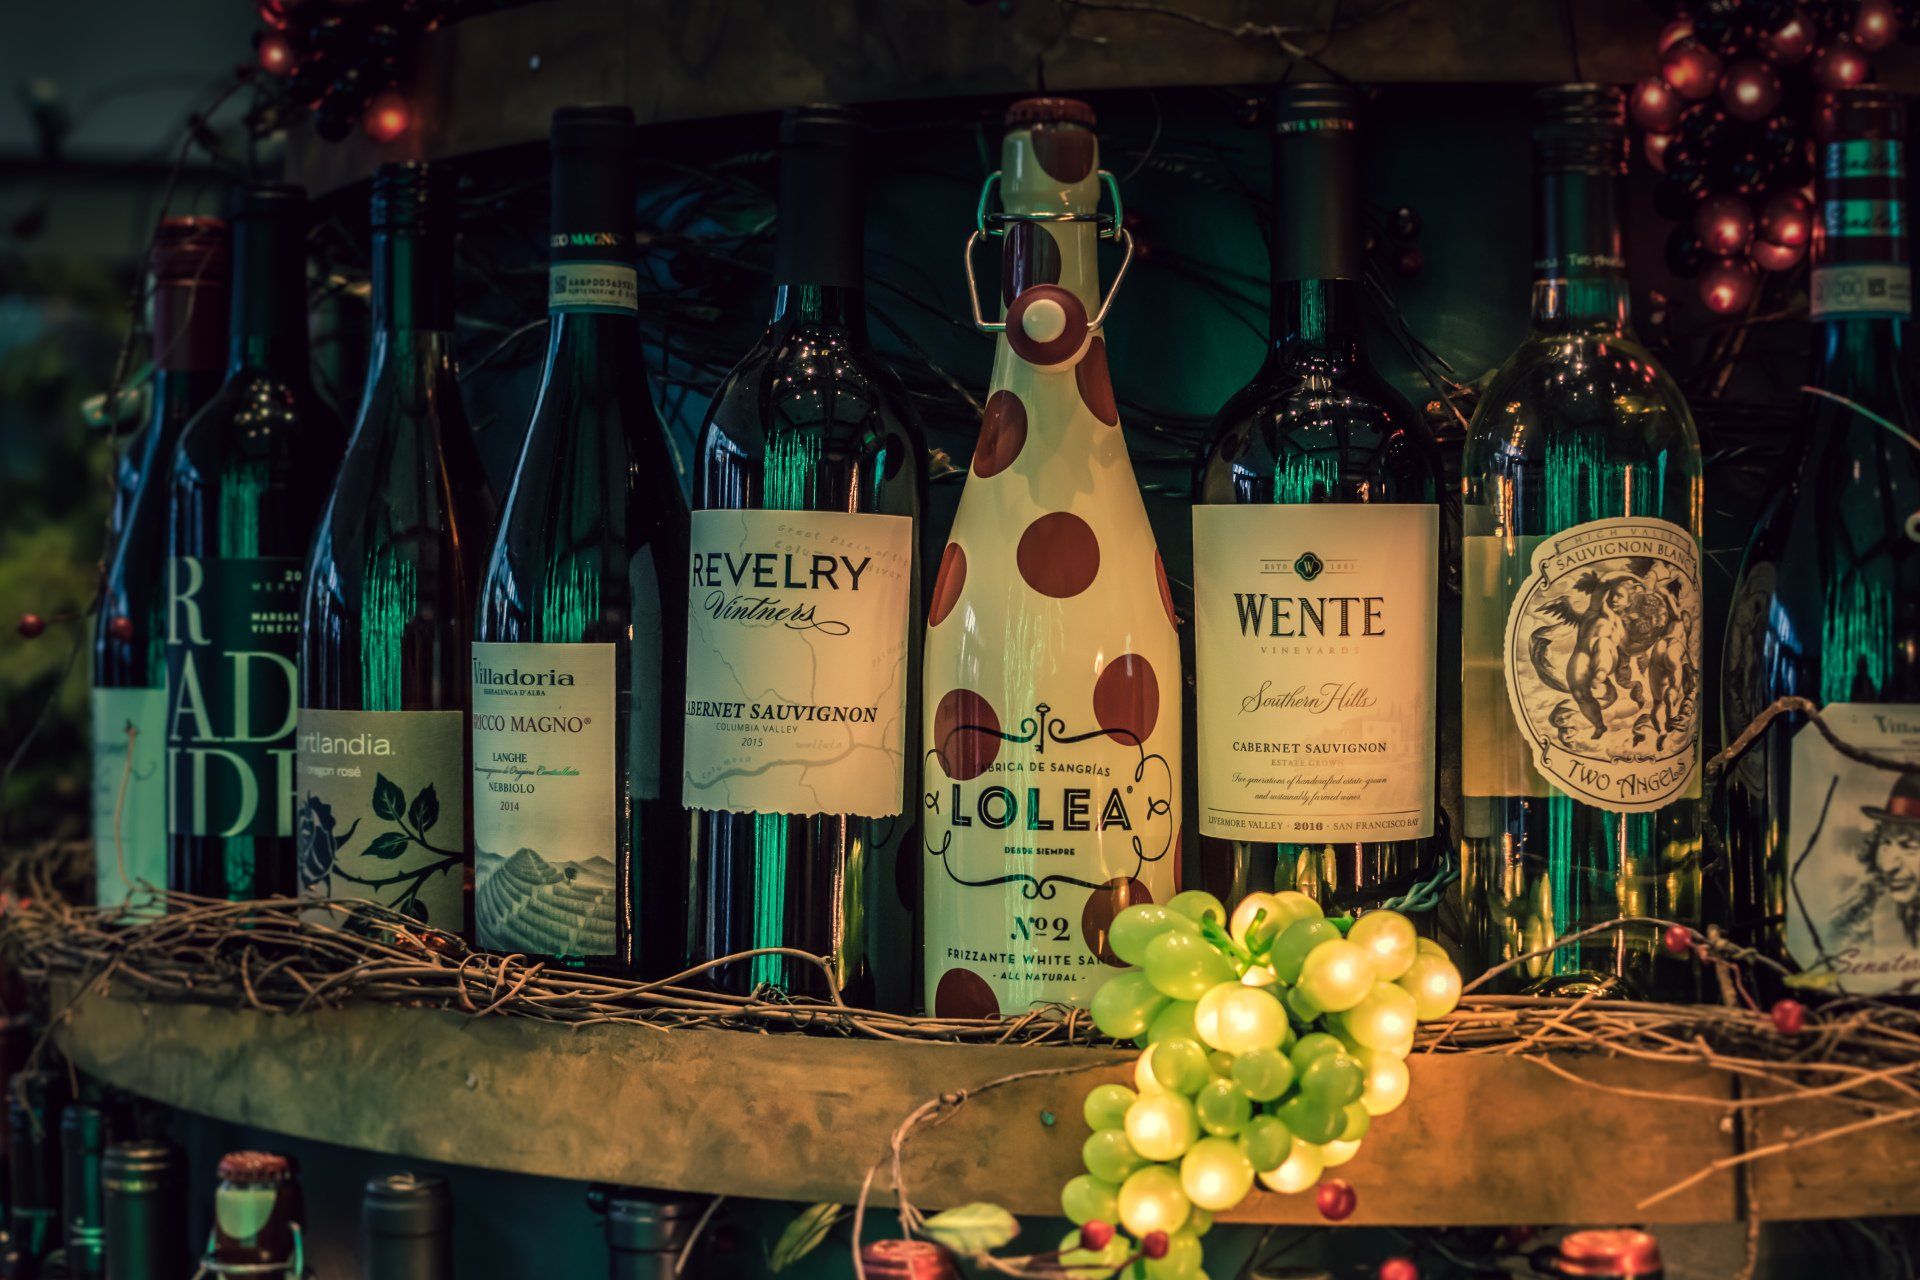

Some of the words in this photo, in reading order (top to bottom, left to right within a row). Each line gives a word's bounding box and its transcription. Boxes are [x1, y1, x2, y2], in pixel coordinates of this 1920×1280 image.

[1556, 540, 1654, 572] SAUVIGNON
[1656, 543, 1695, 572] BLANC
[693, 552, 872, 591] REVELRY
[705, 590, 850, 636] Vintners
[1232, 593, 1387, 638] WENTE
[1260, 646, 1361, 656] VINEYARDS
[473, 658, 574, 687] Villadoria
[1238, 680, 1320, 716] Southern
[1309, 681, 1378, 715] Hills
[750, 703, 878, 722] SAUVIGNON
[473, 714, 505, 731] RICCO
[716, 722, 759, 733] COLUMBIA
[763, 724, 798, 735] VALLEY
[741, 737, 764, 748] 2015
[1232, 741, 1300, 754] CABERNET
[1305, 742, 1388, 755] SAUVIGNON
[493, 752, 528, 763] LANGHE
[1271, 758, 1305, 768] ESTATE
[1029, 762, 1045, 773] DE
[1050, 762, 1110, 777] SANGRÍAS
[1568, 758, 1611, 791] TWO
[489, 782, 535, 794] NEBBIOLO
[1244, 776, 1286, 788] generations
[1296, 774, 1344, 790] handcrafted
[1255, 790, 1271, 800] and
[1270, 790, 1308, 806] sustainably
[1307, 790, 1342, 806] farmed
[500, 801, 520, 812] 2014
[1207, 815, 1246, 829] LIVERMORE
[1248, 819, 1283, 831] VALLEY
[1333, 821, 1353, 831] SAN
[1356, 817, 1406, 831] FRANCISCO
[1407, 816, 1420, 827] BAY
[1036, 847, 1076, 857] SIEMPRE
[947, 947, 1016, 965] FRIZZANTE
[1022, 955, 1071, 966] WHITE
[1000, 972, 1021, 981] ALL
[1025, 972, 1077, 982] NATURAL
